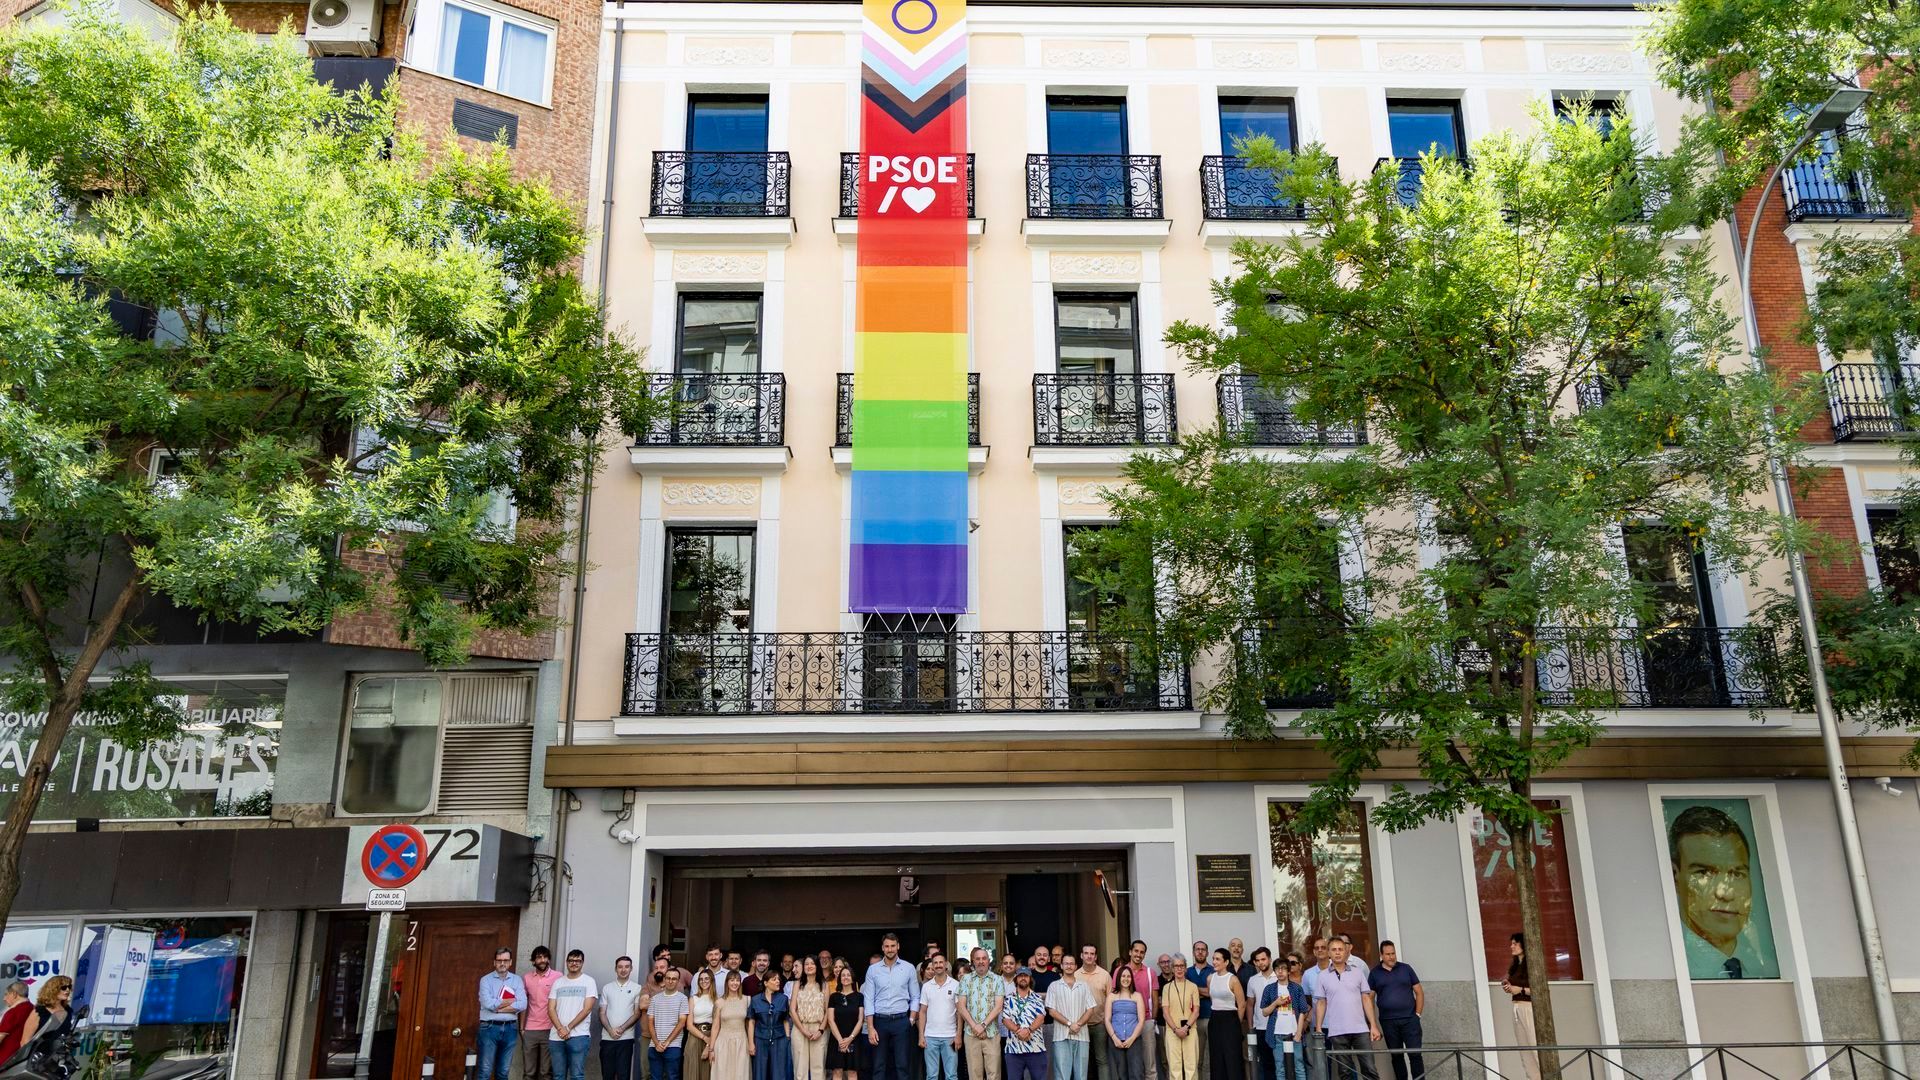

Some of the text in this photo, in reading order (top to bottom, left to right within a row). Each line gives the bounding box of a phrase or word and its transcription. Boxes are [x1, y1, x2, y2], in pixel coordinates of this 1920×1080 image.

[868, 155, 958, 183] PSOE
[1475, 818, 1553, 847] PSE
[423, 828, 480, 870] 72
